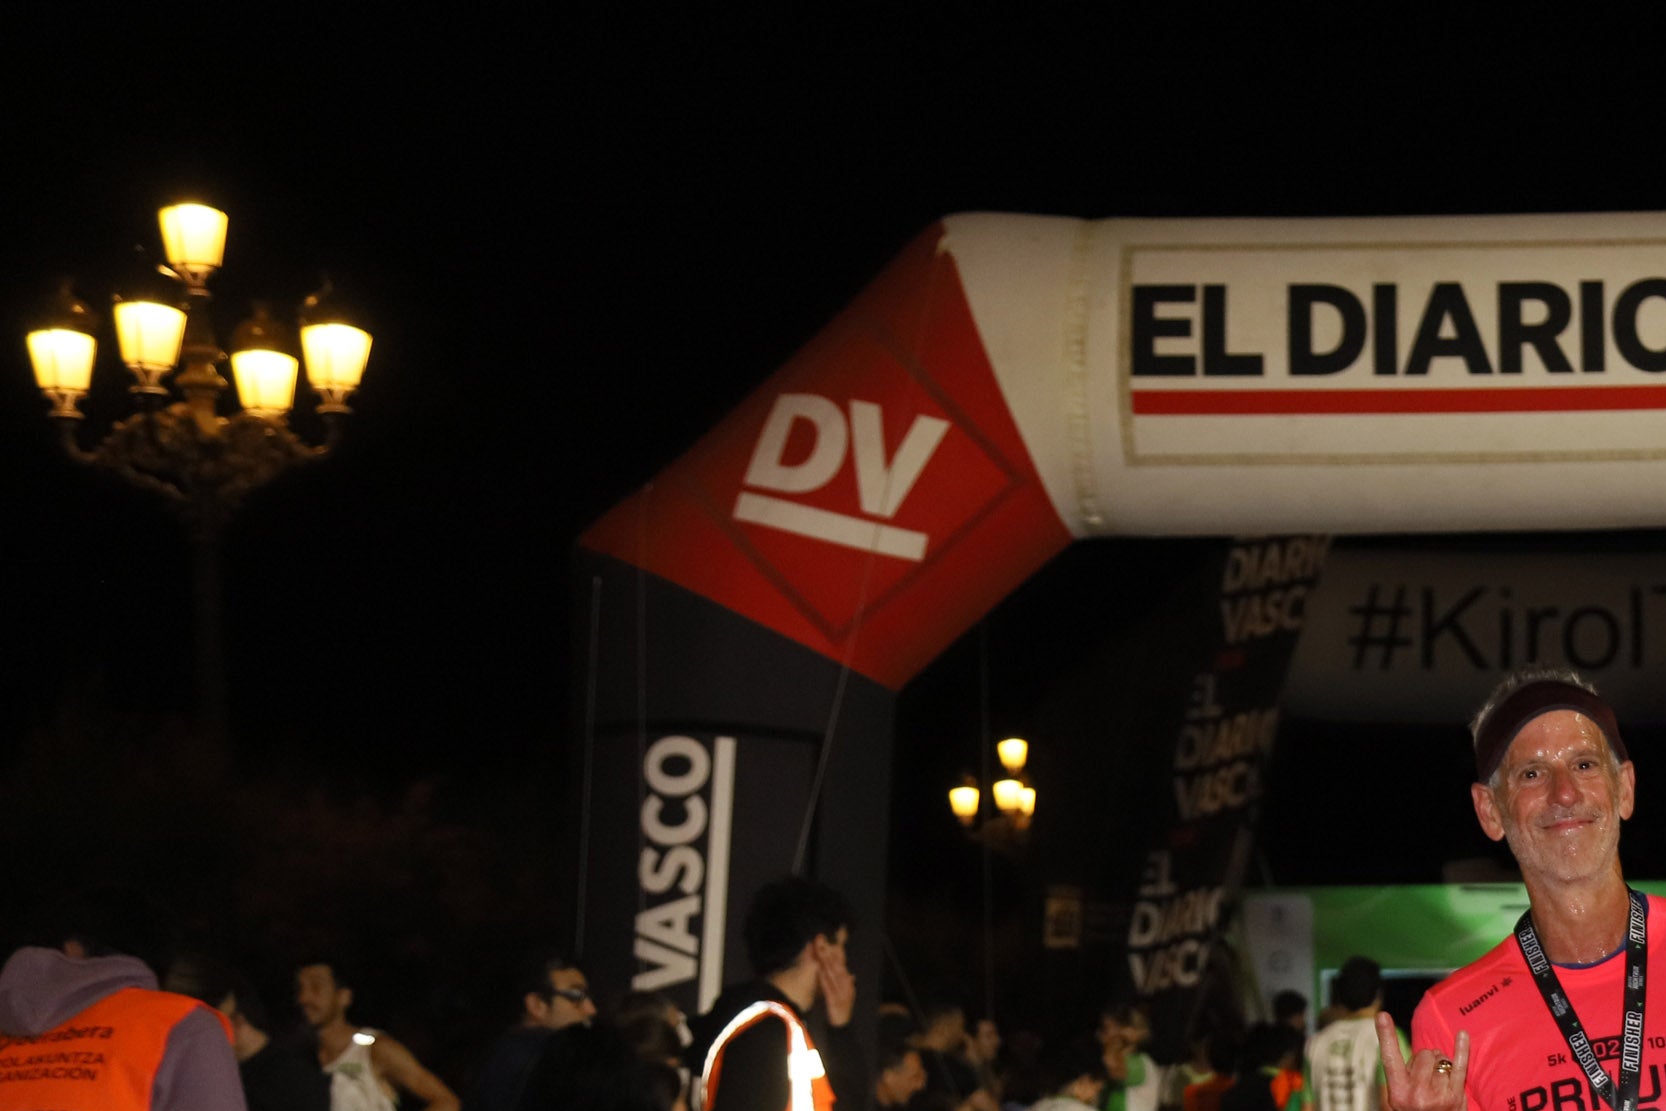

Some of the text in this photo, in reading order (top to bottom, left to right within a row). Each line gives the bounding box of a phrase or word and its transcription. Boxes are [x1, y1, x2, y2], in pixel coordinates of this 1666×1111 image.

[1130, 283, 1264, 378] EL
[744, 392, 951, 519] DV
[631, 734, 713, 992] VASCO
[1518, 927, 1550, 975] FINISHER
[1459, 984, 1499, 1016] luanvi
[1547, 1052, 1567, 1068] 5k
[1568, 1030, 1608, 1089] FINISHER
[1622, 1010, 1643, 1073] FINISHER
